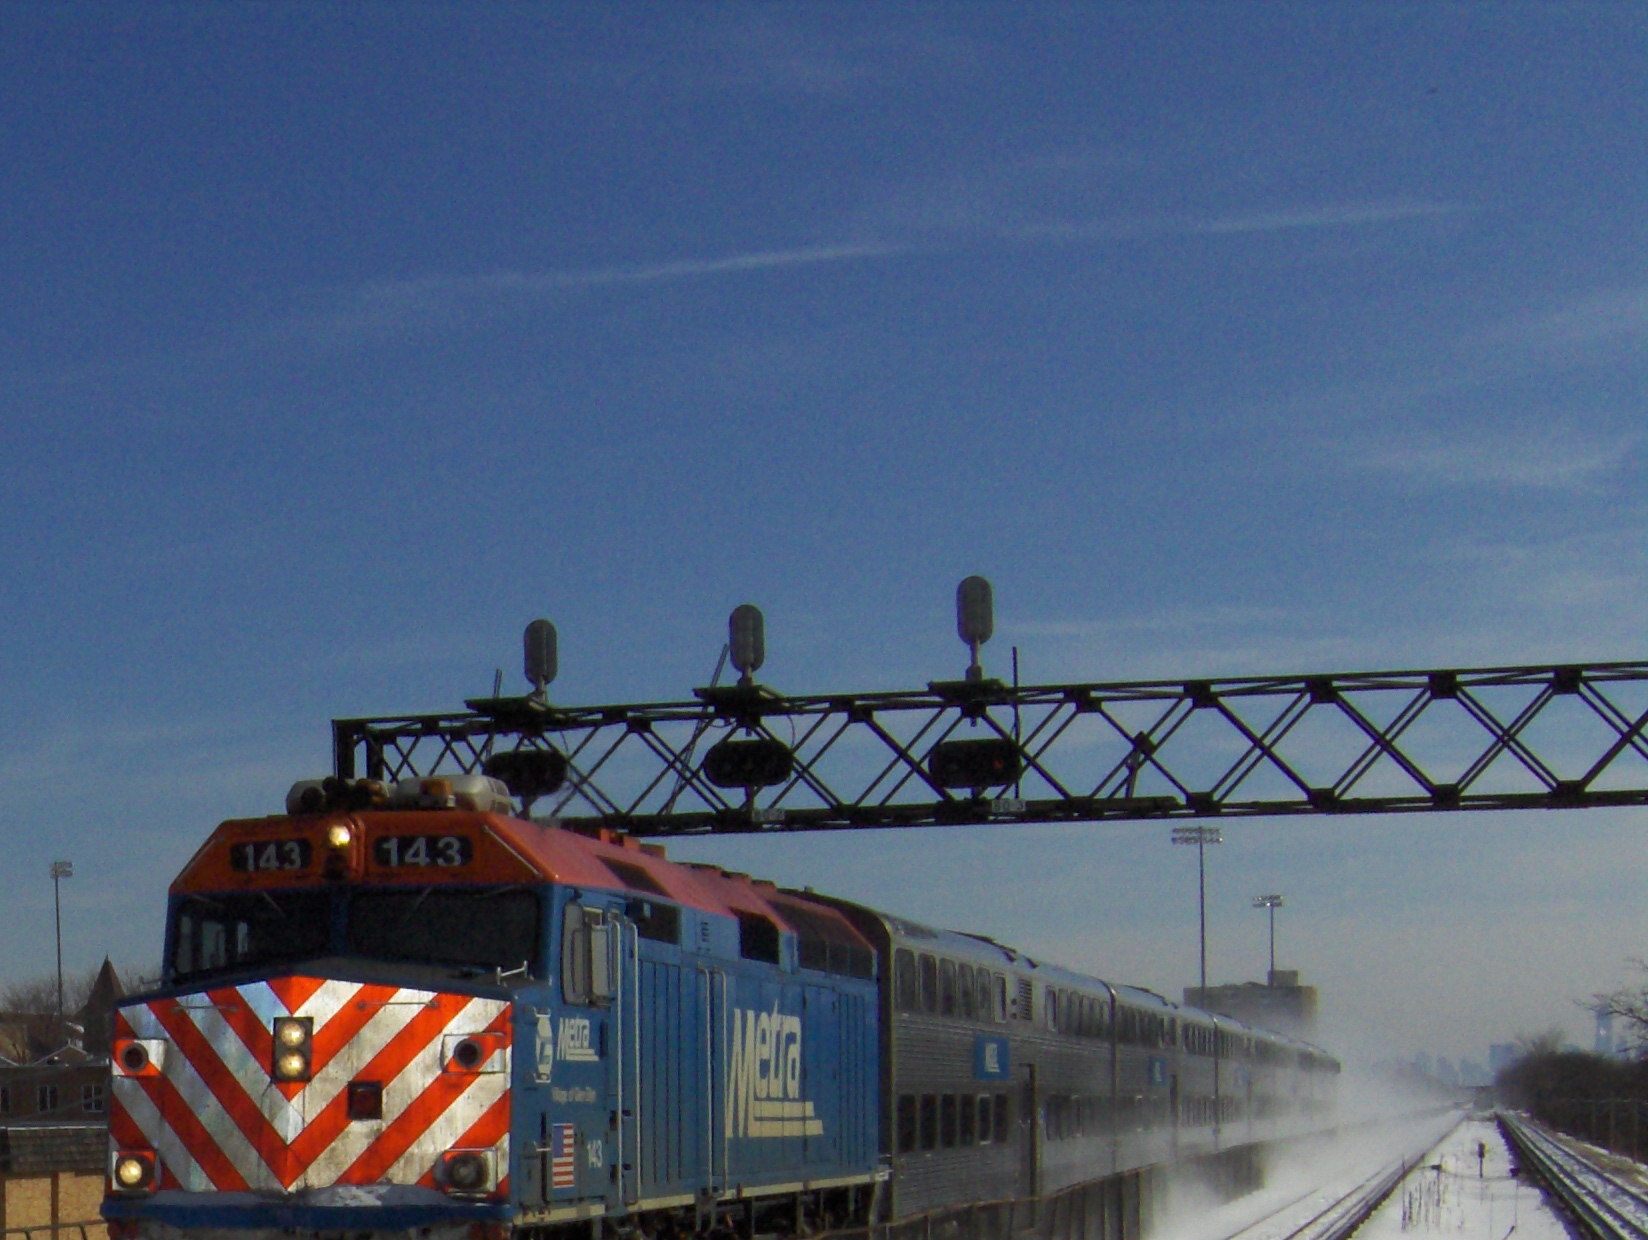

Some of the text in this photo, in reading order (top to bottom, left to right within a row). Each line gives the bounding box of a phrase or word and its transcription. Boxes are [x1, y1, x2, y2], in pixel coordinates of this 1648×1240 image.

[245, 841, 302, 872] 143
[382, 836, 462, 867] 143
[556, 1016, 600, 1062] Metra
[725, 998, 822, 1138] Metra
[587, 1139, 602, 1168] 143
